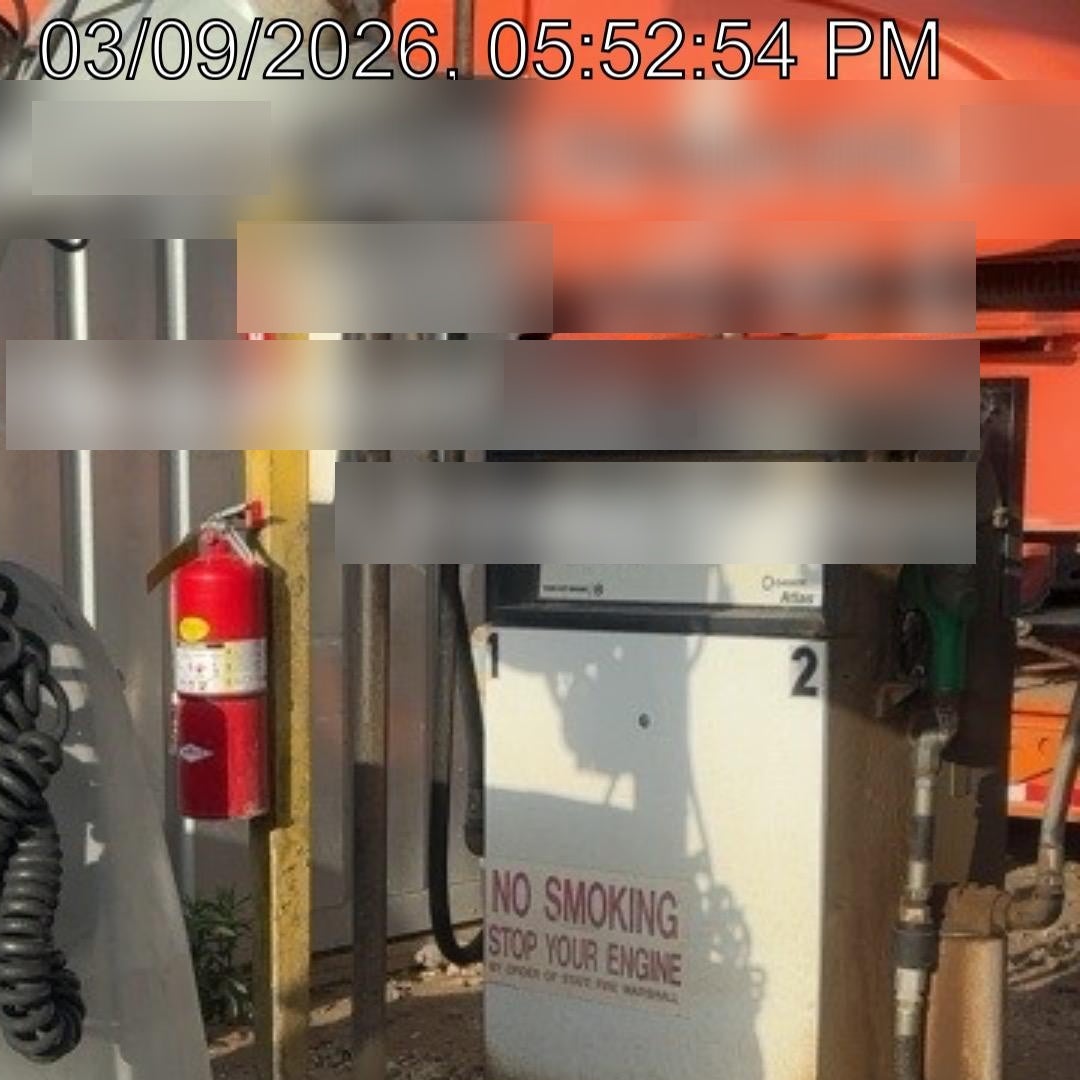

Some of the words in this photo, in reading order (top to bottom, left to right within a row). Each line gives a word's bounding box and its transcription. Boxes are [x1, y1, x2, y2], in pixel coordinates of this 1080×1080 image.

[487, 632, 499, 679] 1
[790, 646, 820, 697] 2
[492, 869, 532, 919] NO
[544, 875, 679, 940] SMOKING
[488, 923, 537, 961] STOP
[545, 932, 598, 972] YOUR
[606, 942, 682, 987] ENGINE
